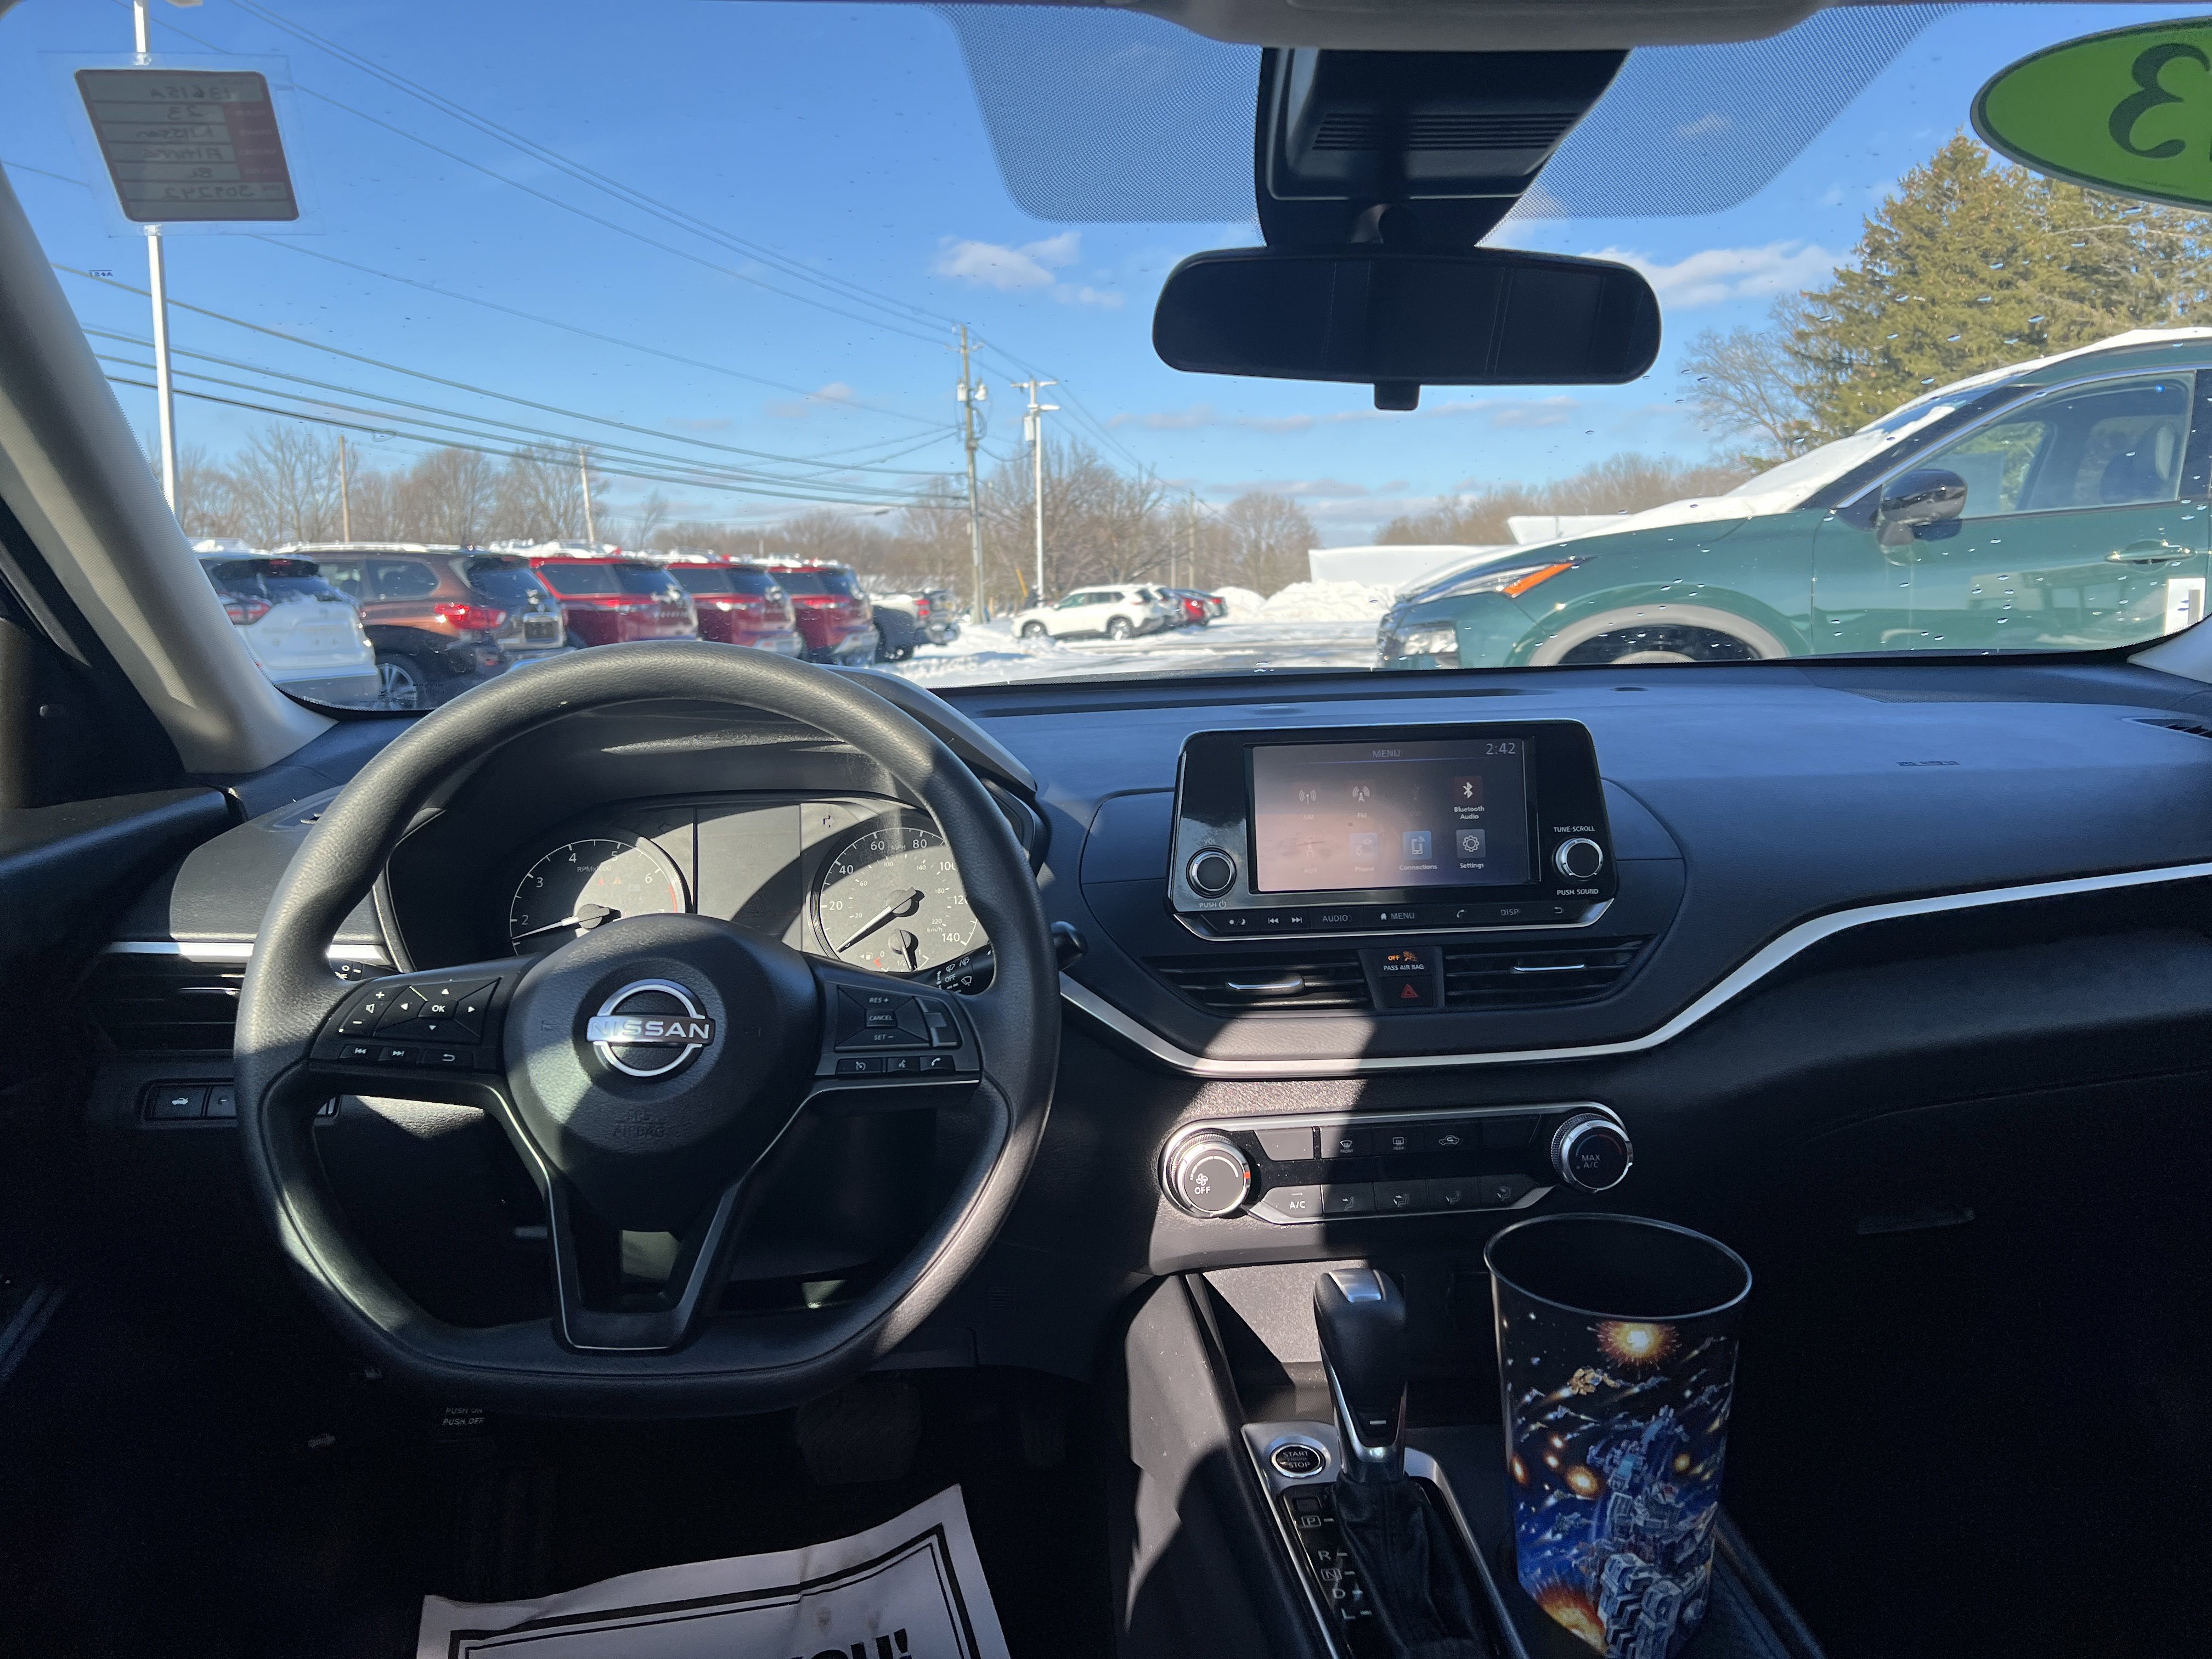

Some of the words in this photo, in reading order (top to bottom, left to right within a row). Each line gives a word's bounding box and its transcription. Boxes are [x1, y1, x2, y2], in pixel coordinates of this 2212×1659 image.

[1372, 749, 1401, 758] MENU
[1486, 743, 1516, 755] 2:42
[870, 841, 884, 850] 60
[912, 839, 927, 848] 80
[568, 853, 577, 863] 4
[611, 851, 618, 861] 5
[839, 865, 854, 874] 40
[535, 877, 543, 888] 3
[645, 873, 652, 883] 6
[953, 895, 968, 905] 12
[829, 901, 843, 910] 20
[521, 915, 528, 926] 2
[1322, 914, 1348, 922] AUDIO
[941, 932, 960, 943] 140
[944, 974, 956, 983] OFF
[432, 1005, 445, 1013] OK
[590, 1020, 710, 1039] NISSAN
[1194, 1186, 1211, 1194] OFF
[1289, 1200, 1306, 1209] A/C
[1318, 1550, 1331, 1560] R
[1333, 1588, 1346, 1599] D
[1341, 1608, 1356, 1620] L
